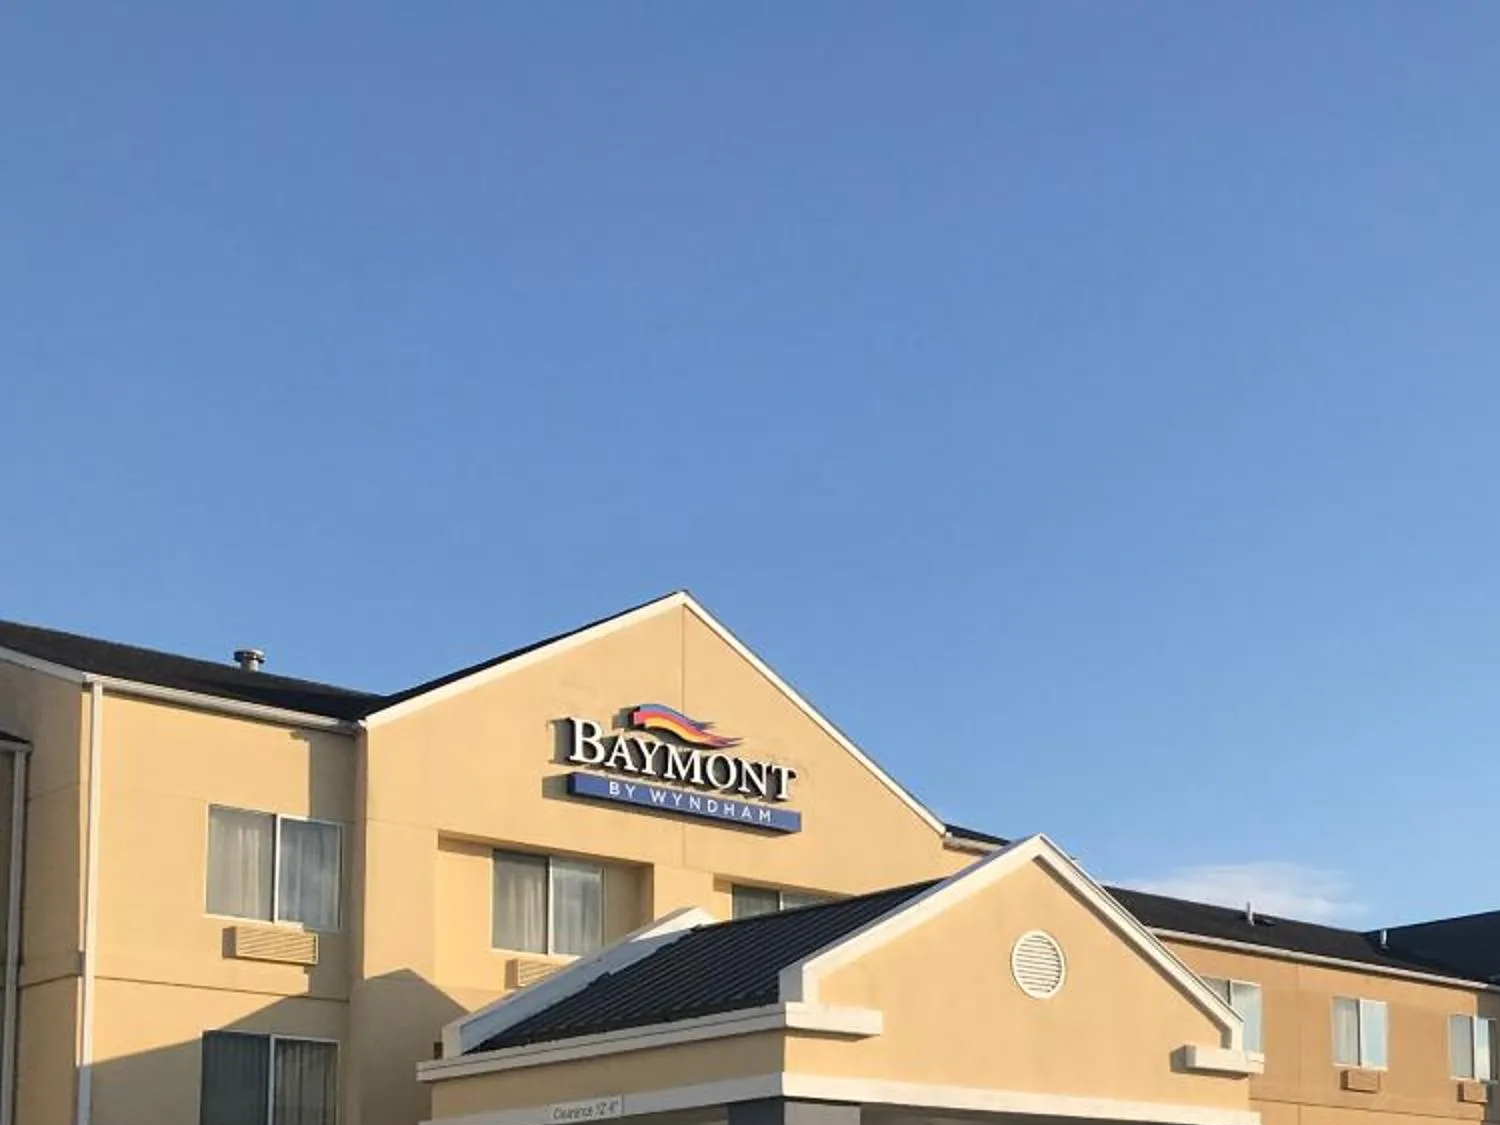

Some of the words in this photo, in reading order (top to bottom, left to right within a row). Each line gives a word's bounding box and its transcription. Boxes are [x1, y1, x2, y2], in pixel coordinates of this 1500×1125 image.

[569, 717, 798, 799] BAYMONT
[609, 781, 636, 799] BY
[649, 787, 771, 823] WYNDHAM
